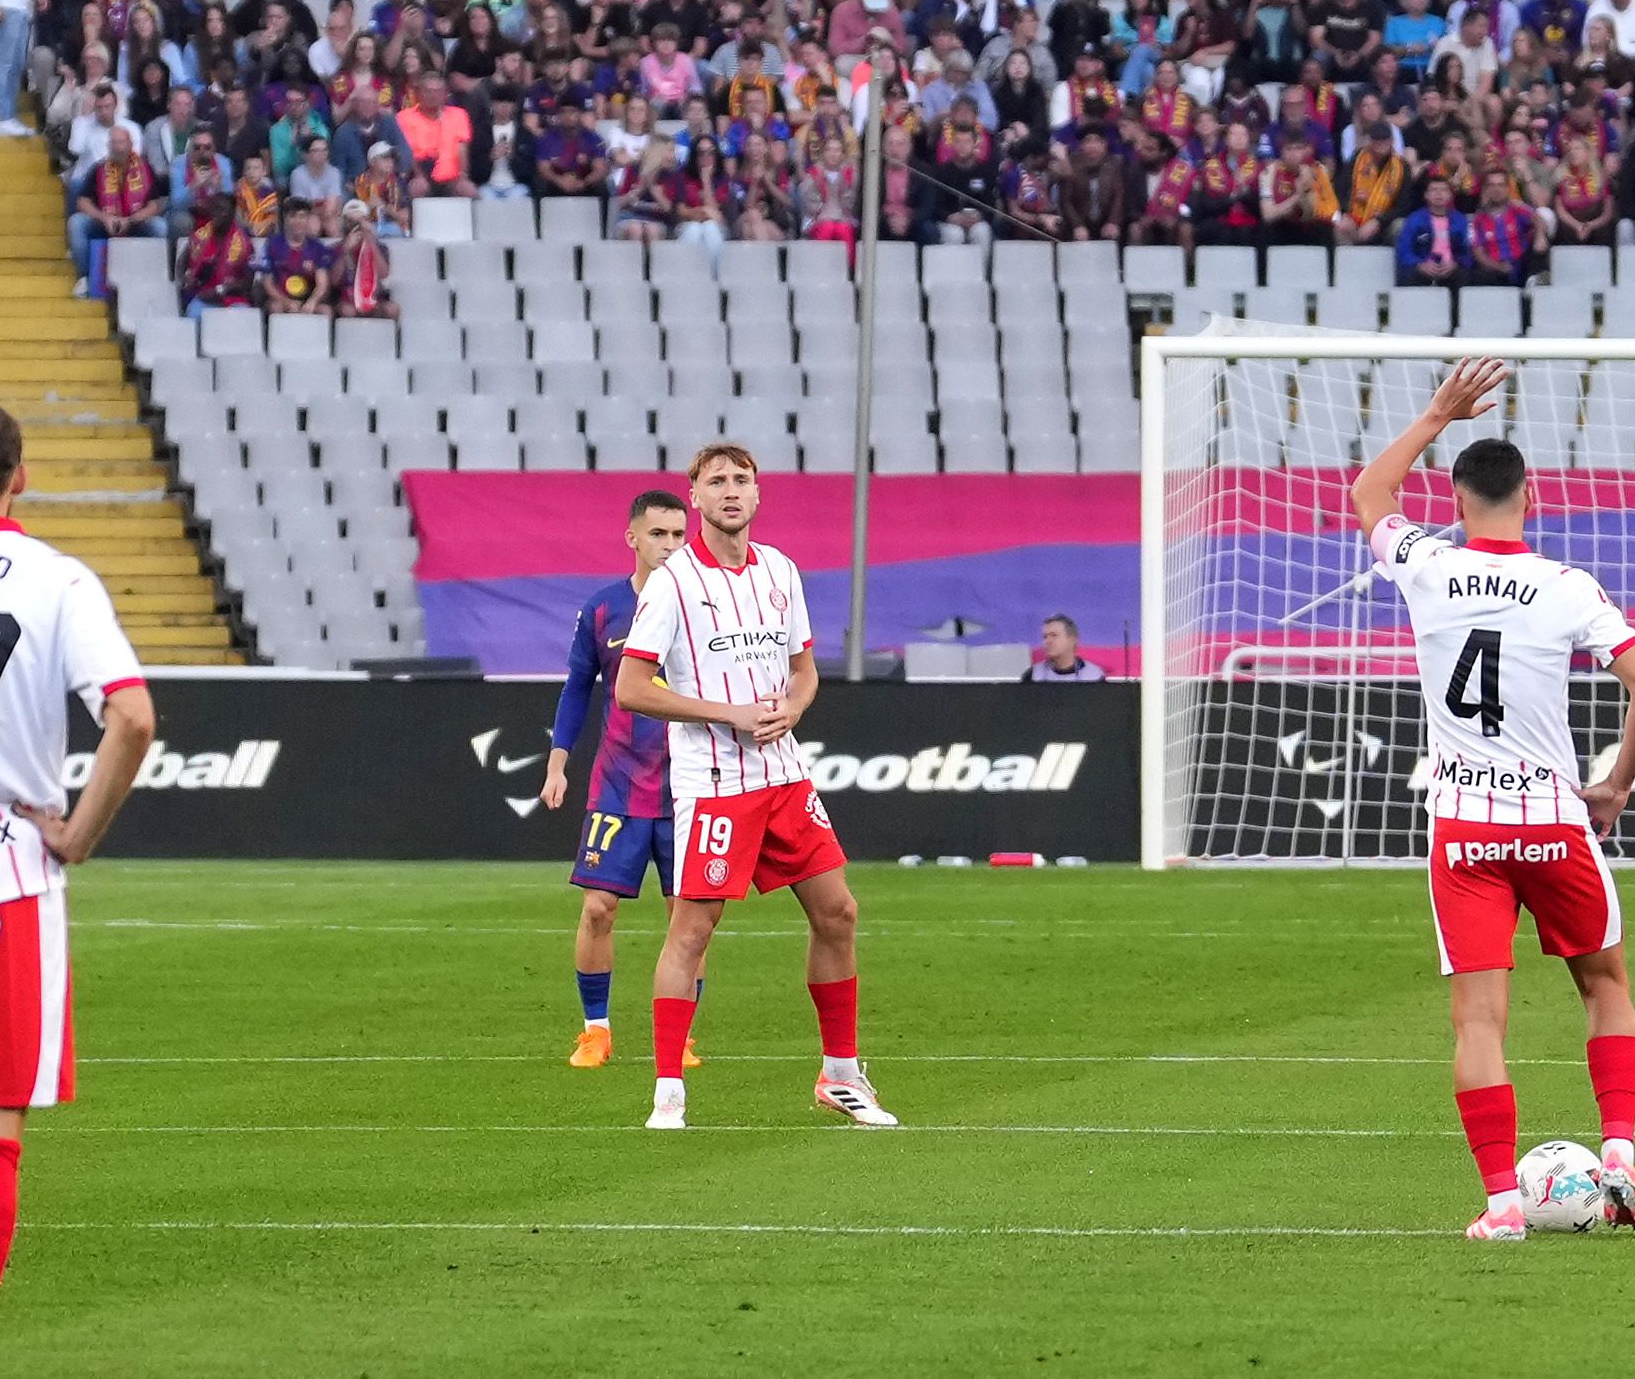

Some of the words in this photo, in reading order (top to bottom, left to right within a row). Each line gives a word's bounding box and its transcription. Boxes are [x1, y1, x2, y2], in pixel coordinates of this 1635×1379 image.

[1448, 574, 1538, 606] ARNAU
[734, 649, 778, 664] AIRWAYS
[1445, 628, 1505, 738] 4
[1439, 758, 1532, 792] Marlex
[586, 811, 623, 851] 17
[697, 812, 734, 856] 19
[1465, 837, 1568, 867] parlem
